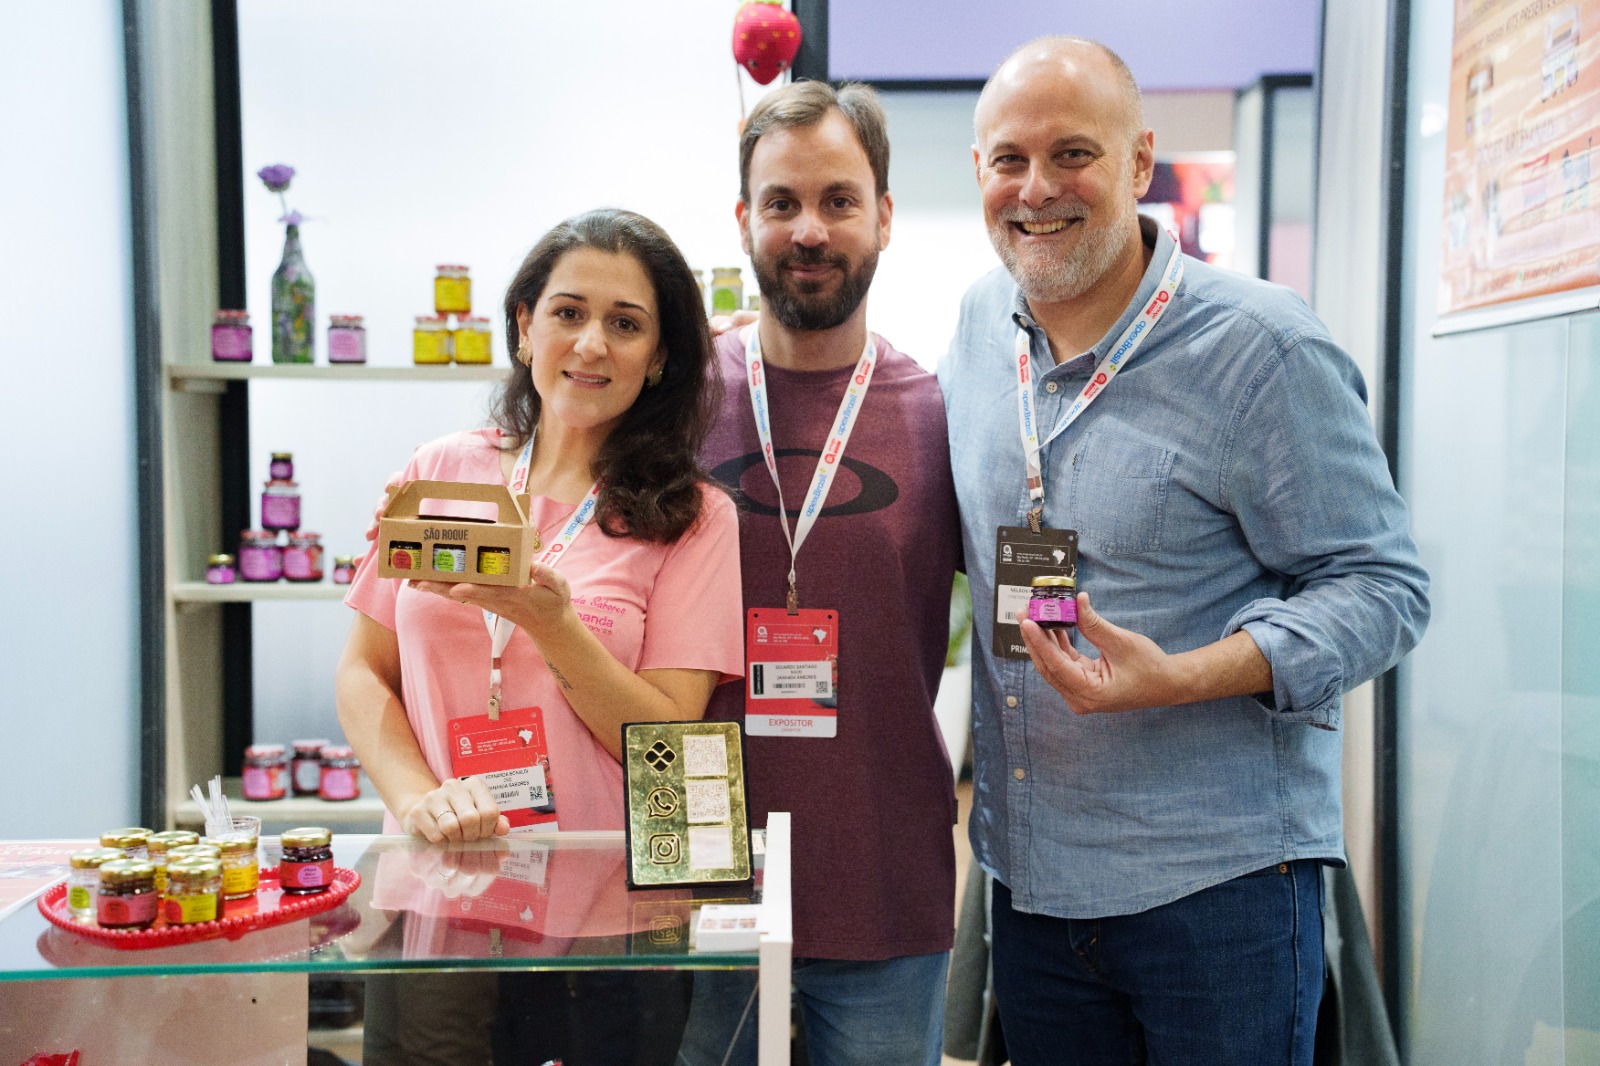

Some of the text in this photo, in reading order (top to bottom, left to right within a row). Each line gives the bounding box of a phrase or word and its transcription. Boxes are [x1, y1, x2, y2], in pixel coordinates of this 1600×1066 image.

[1110, 320, 1147, 364] apexBrasil
[837, 394, 858, 435] apexBrasil
[1022, 390, 1034, 436] apexBrasil
[805, 474, 827, 518] apexBrasil
[423, 527, 469, 541] SÃO ROQUE
[564, 499, 595, 536] apexBrasil
[1010, 644, 1031, 654] PRIM
[768, 718, 813, 727] EXPOSITOR
